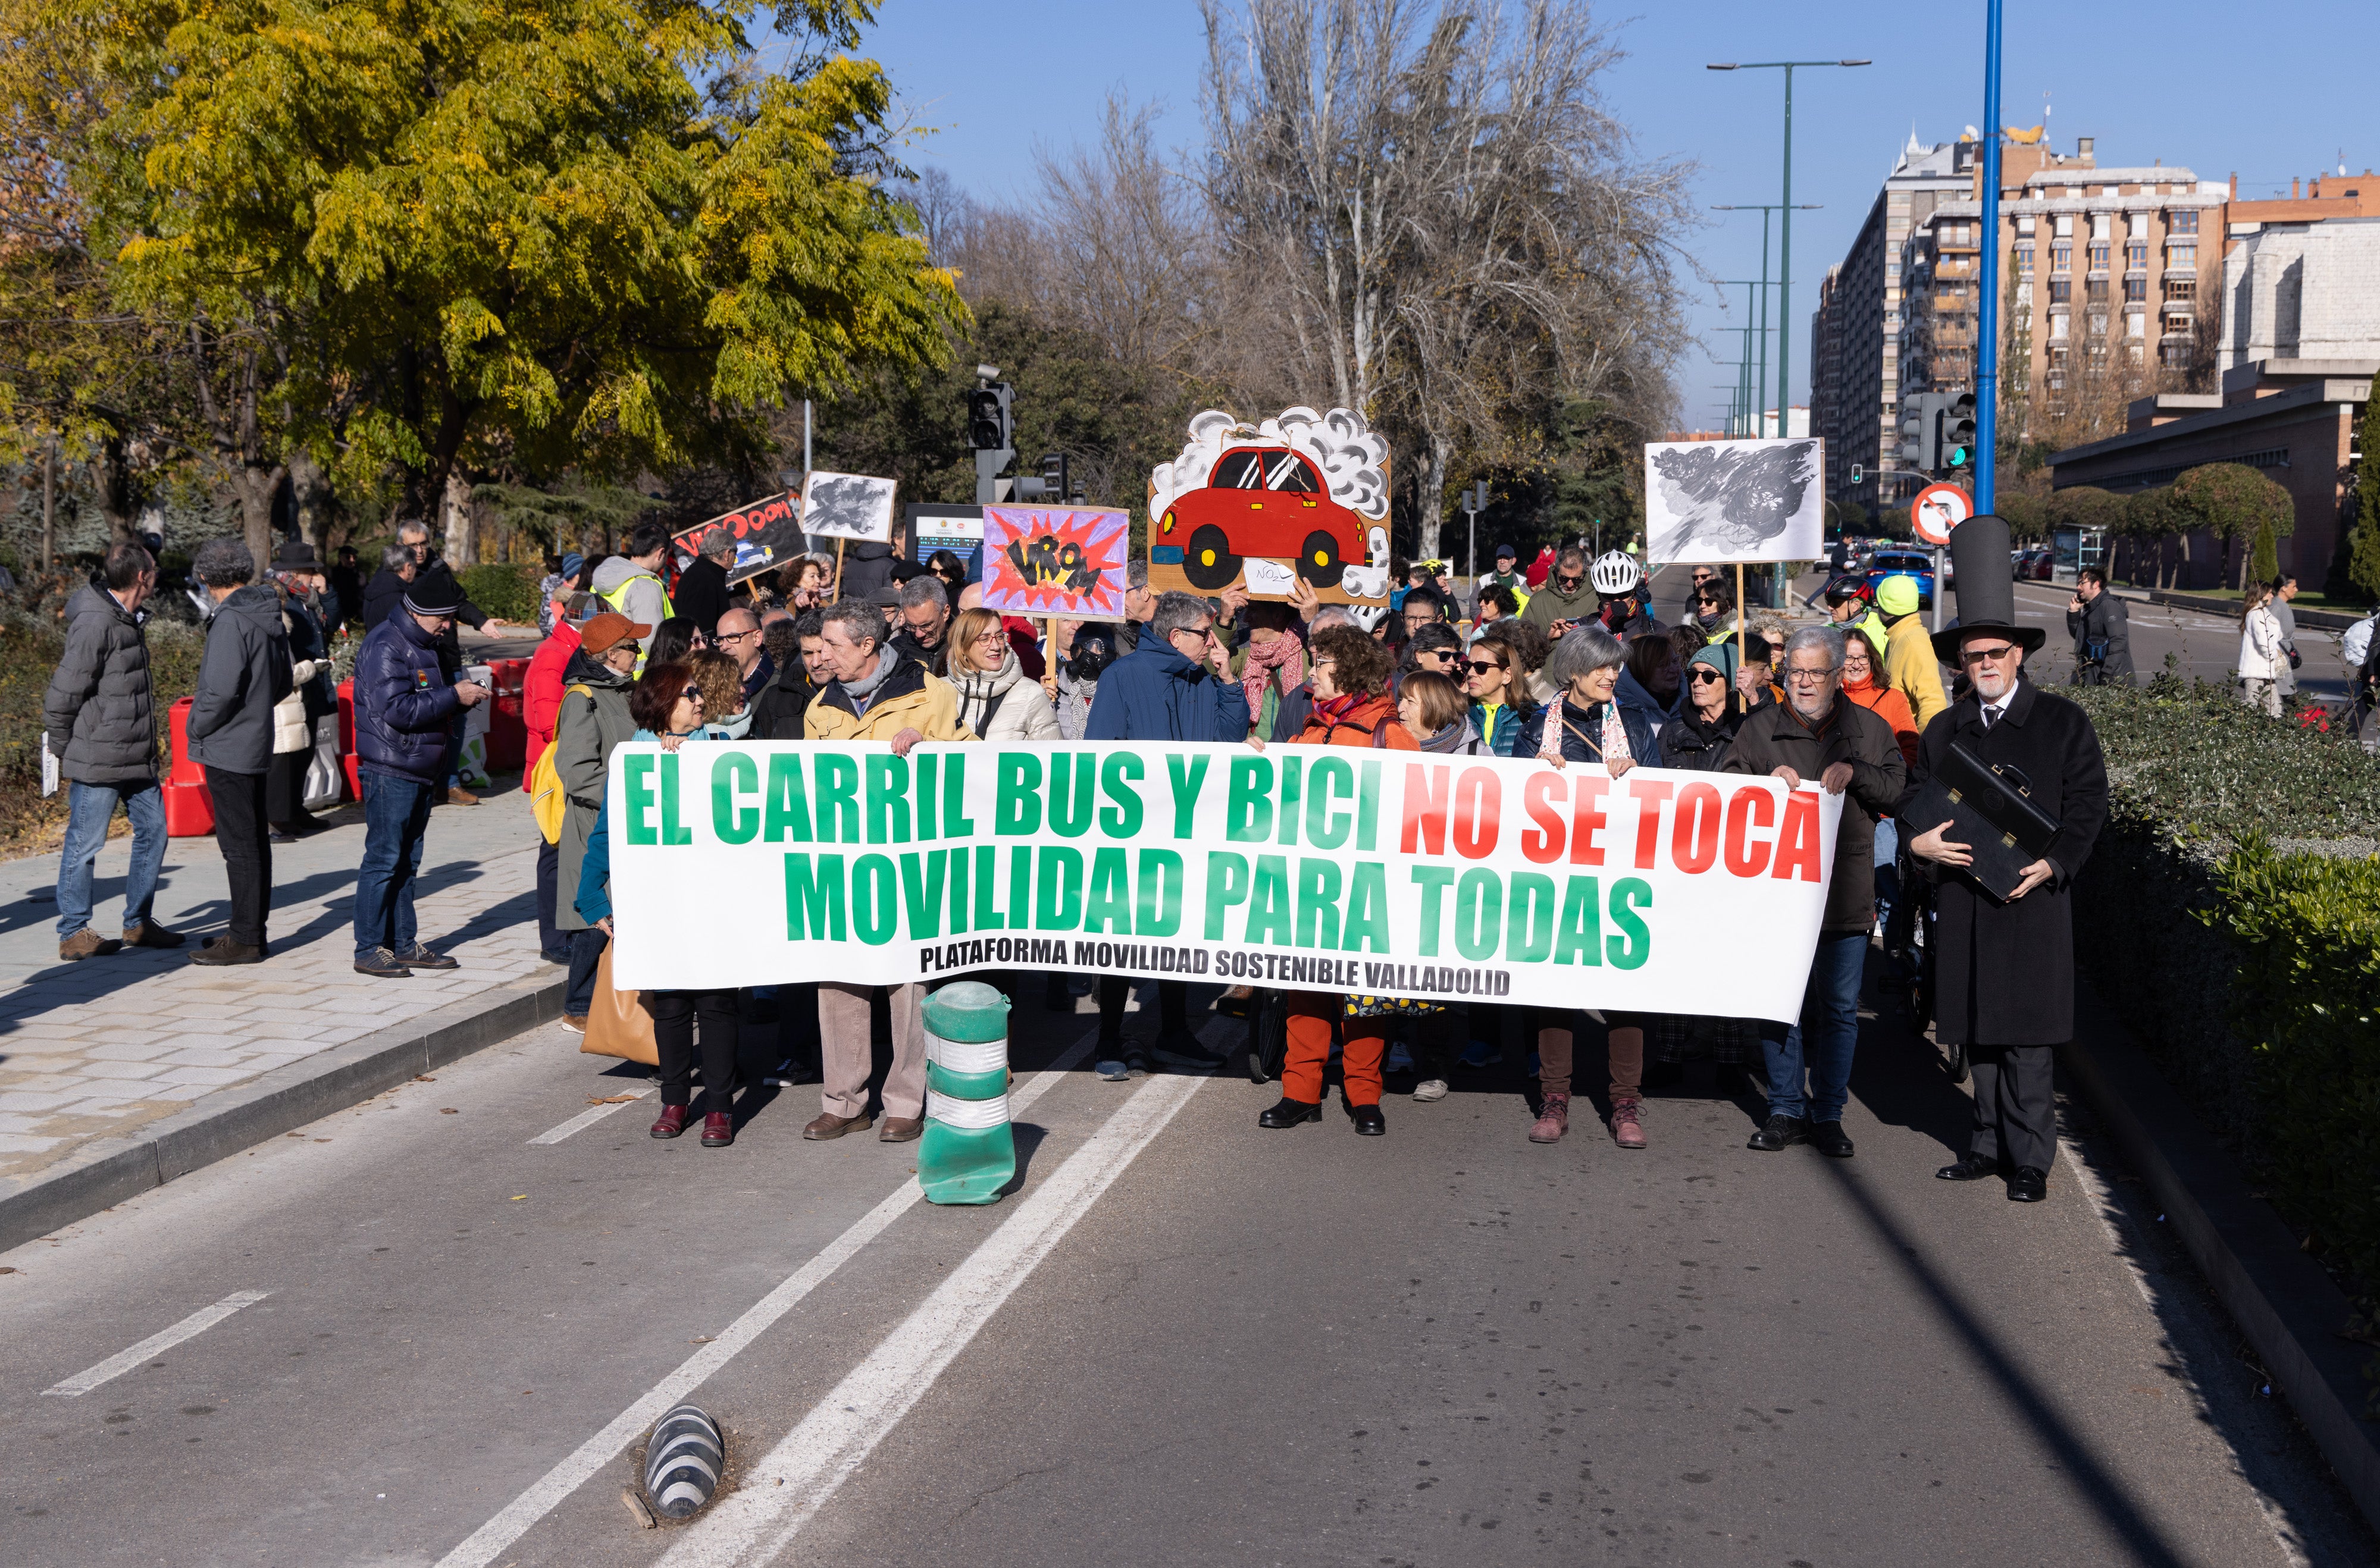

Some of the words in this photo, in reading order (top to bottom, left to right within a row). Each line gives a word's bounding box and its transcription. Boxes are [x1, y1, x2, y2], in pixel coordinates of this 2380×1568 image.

[624, 753, 693, 846] EL
[711, 751, 975, 845] CARRIL
[995, 751, 1145, 839] BUS
[1166, 754, 1210, 840] Y
[1226, 754, 1381, 852] BICI
[1400, 763, 1502, 860] NO
[1521, 772, 1609, 866] SE
[1629, 779, 1821, 883] TOCA
[784, 845, 1183, 947] MOVILIDAD
[1204, 851, 1391, 954] PARA
[1411, 864, 1653, 971] TODAS
[920, 937, 1068, 973] PLATAFORMA
[1074, 941, 1208, 974] MOVILIDAD
[1214, 949, 1358, 987] SOSTENIBLE
[1364, 962, 1510, 996] VALLADOLID
